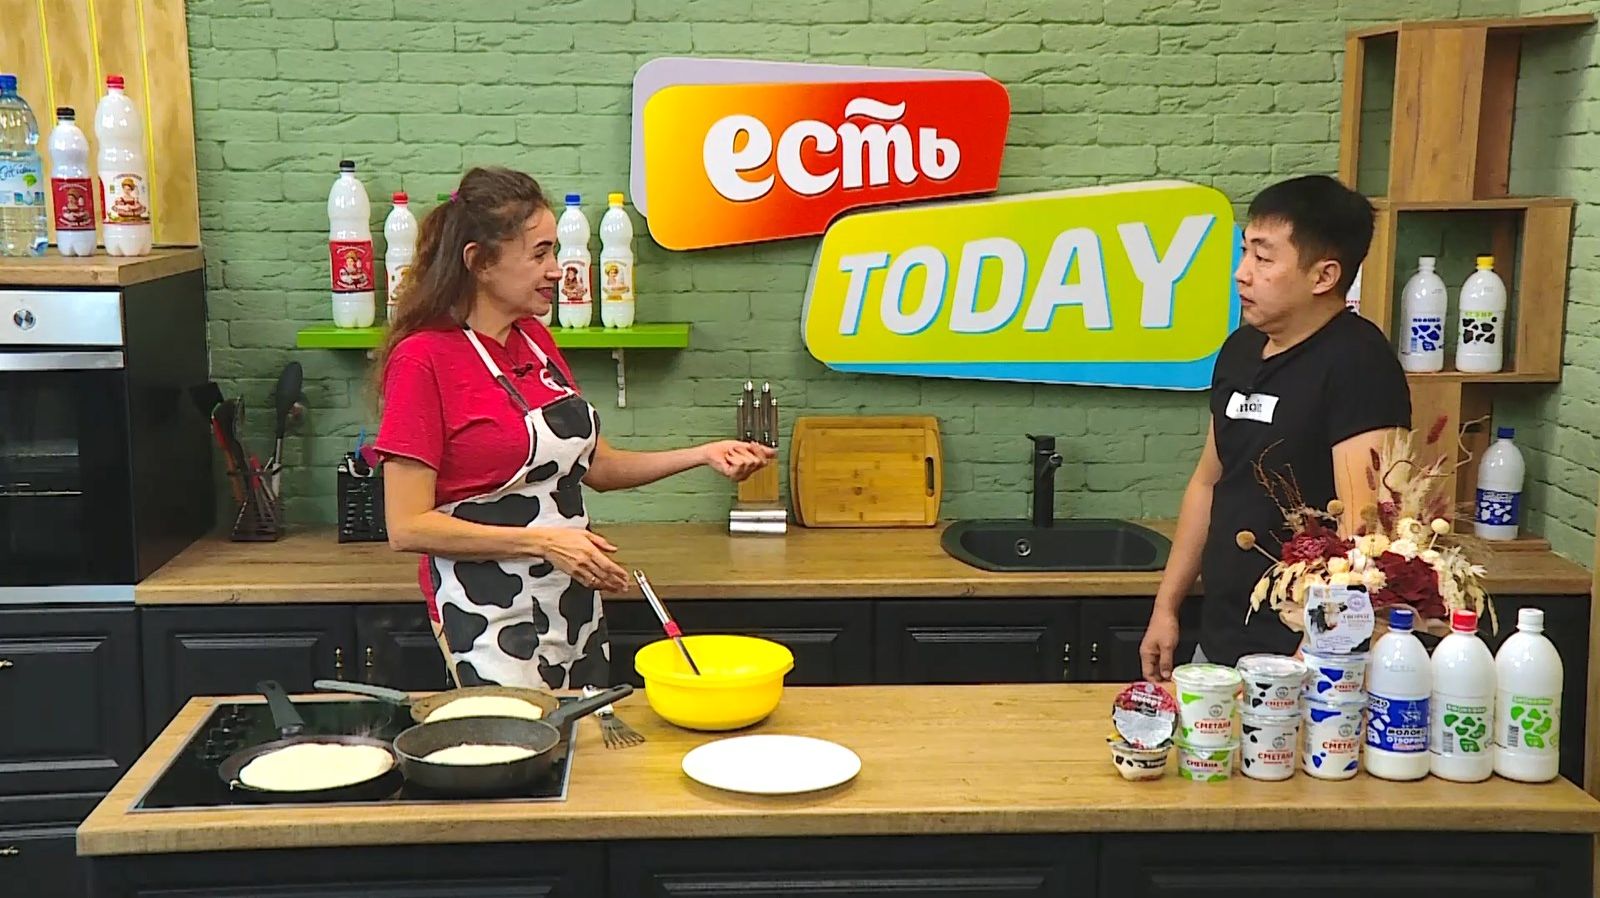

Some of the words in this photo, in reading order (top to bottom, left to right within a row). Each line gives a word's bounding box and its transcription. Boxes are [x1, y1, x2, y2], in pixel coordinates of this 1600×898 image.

[702, 96, 961, 202] есть
[838, 213, 1216, 336] TODAY
[1194, 720, 1231, 730] СМЕТАНА
[1257, 752, 1294, 761] СМЕТАНА
[1186, 760, 1218, 768] СМЕТАНА
